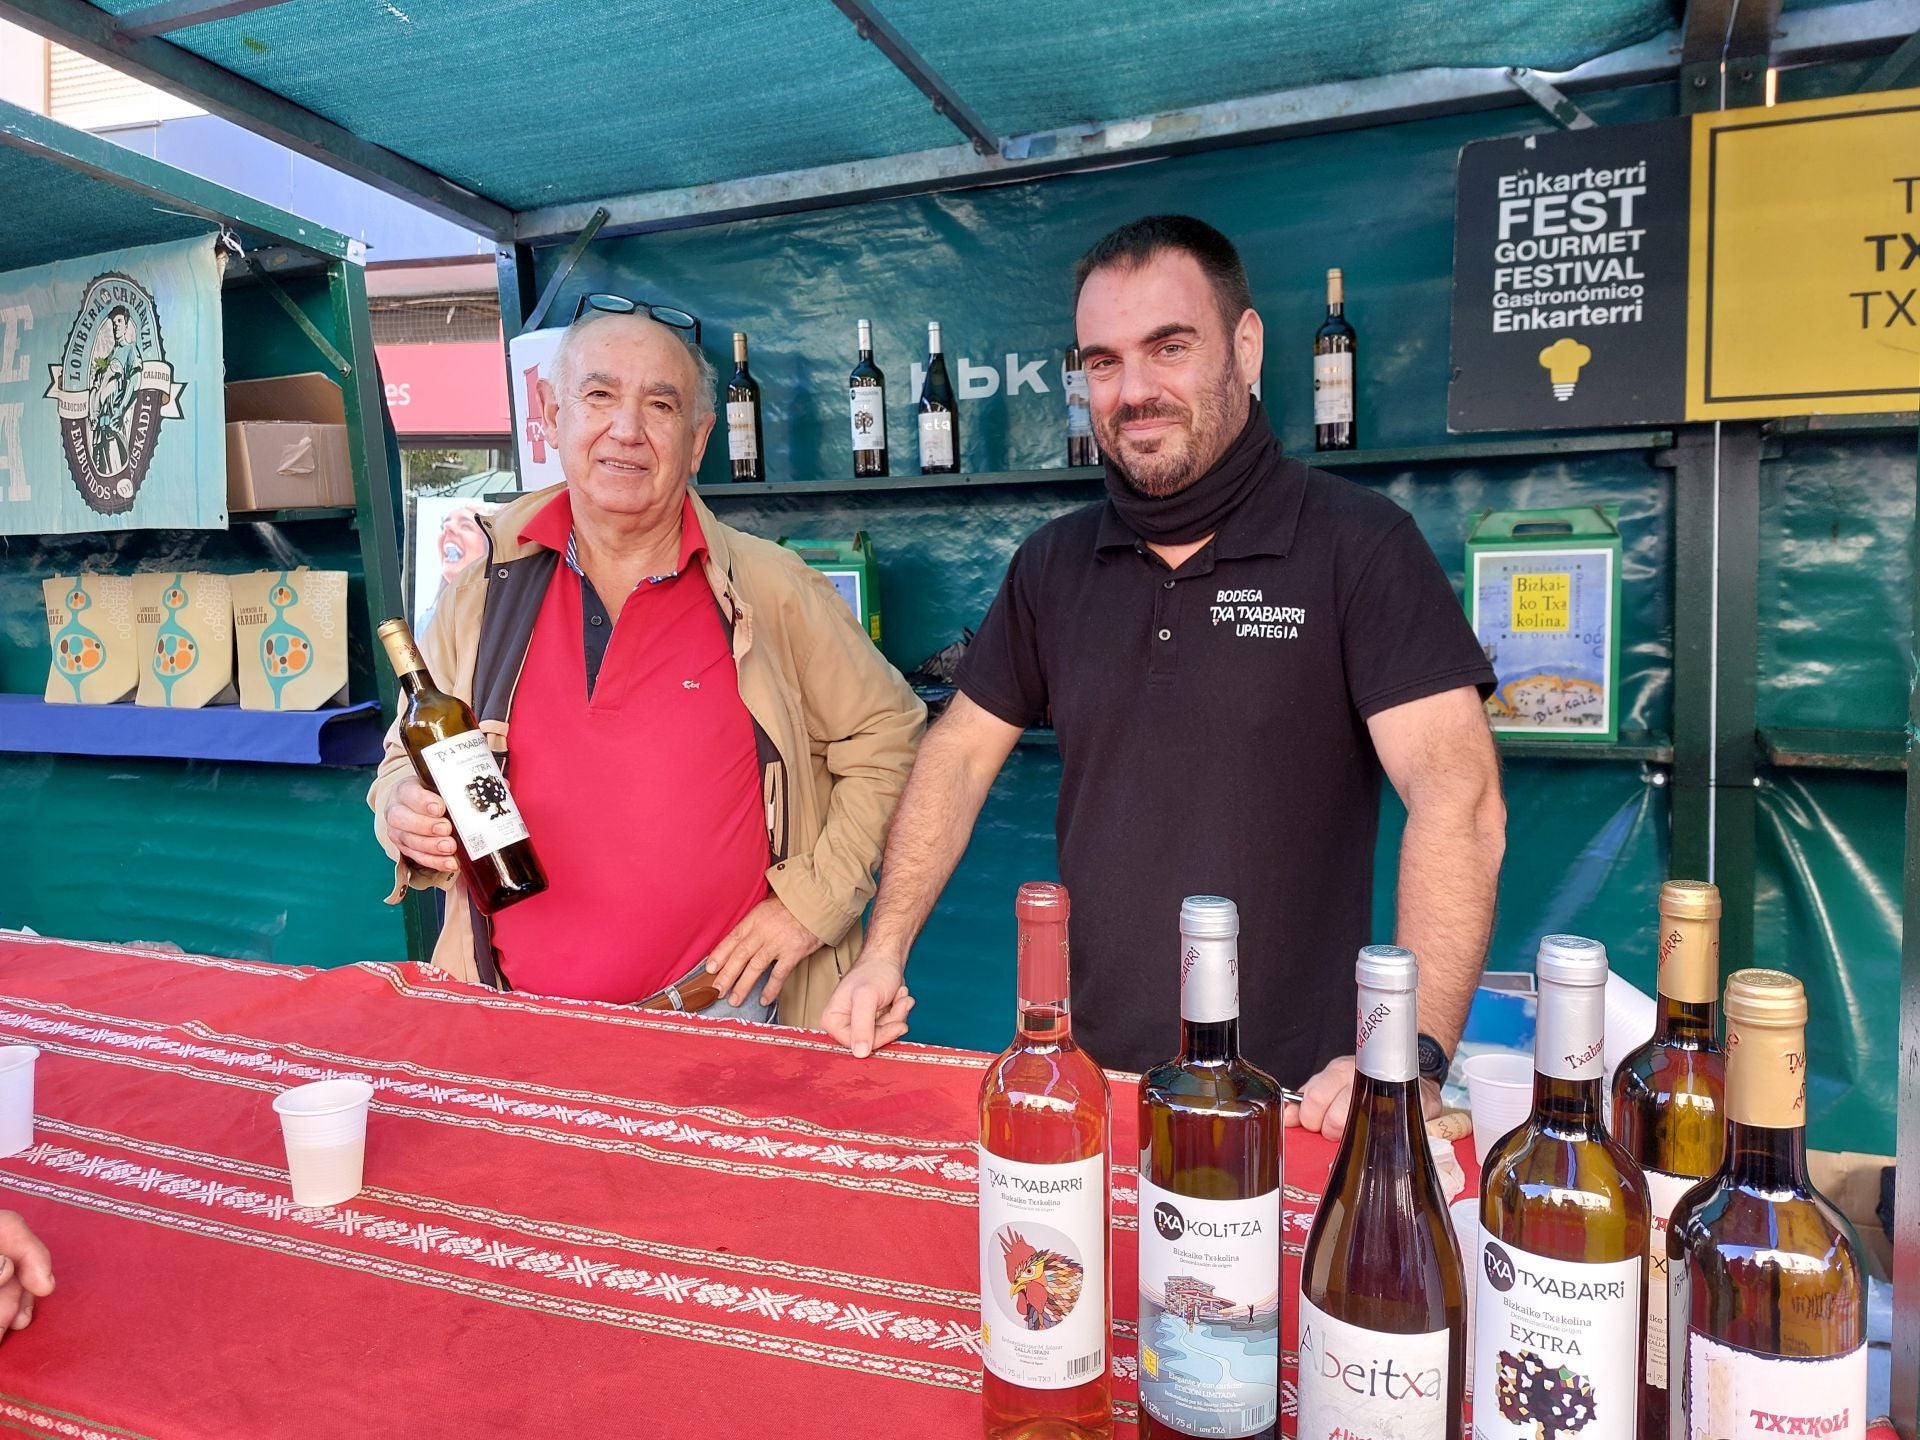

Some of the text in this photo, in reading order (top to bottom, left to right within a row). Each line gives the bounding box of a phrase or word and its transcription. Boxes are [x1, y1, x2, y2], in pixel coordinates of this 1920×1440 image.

[1498, 160, 1647, 199] Enkarterri
[1498, 186, 1647, 240] FEST
[1494, 229, 1647, 264] GOURMET
[1494, 256, 1646, 292] FESTIVAL
[1492, 283, 1645, 309] Gastronómico
[1849, 288, 1917, 330] TX
[1493, 299, 1644, 333] Enkarterri
[70, 303, 105, 381] LOMBERA
[112, 286, 152, 352] CARRANZA
[60, 399, 87, 413] RADICION
[71, 426, 111, 500] EMBUTIDOS
[129, 404, 152, 478] USKADI
[1216, 590, 1263, 603] BODEGA
[1517, 577, 1567, 592] Bizkai-
[1210, 606, 1235, 623] TXA
[1519, 595, 1568, 611] ko Txa
[1236, 624, 1298, 639] UPATEGIA
[1516, 612, 1566, 628] kolina.
[988, 1167, 1008, 1188] TXA
[1154, 1208, 1184, 1233] TXA
[1173, 1247, 1240, 1263] Bizkaiko Txakolina
[1485, 1249, 1514, 1284] TXA
[1503, 1296, 1592, 1327] Bizkaiko Txakolina
[1509, 1322, 1582, 1356] EXTRA
